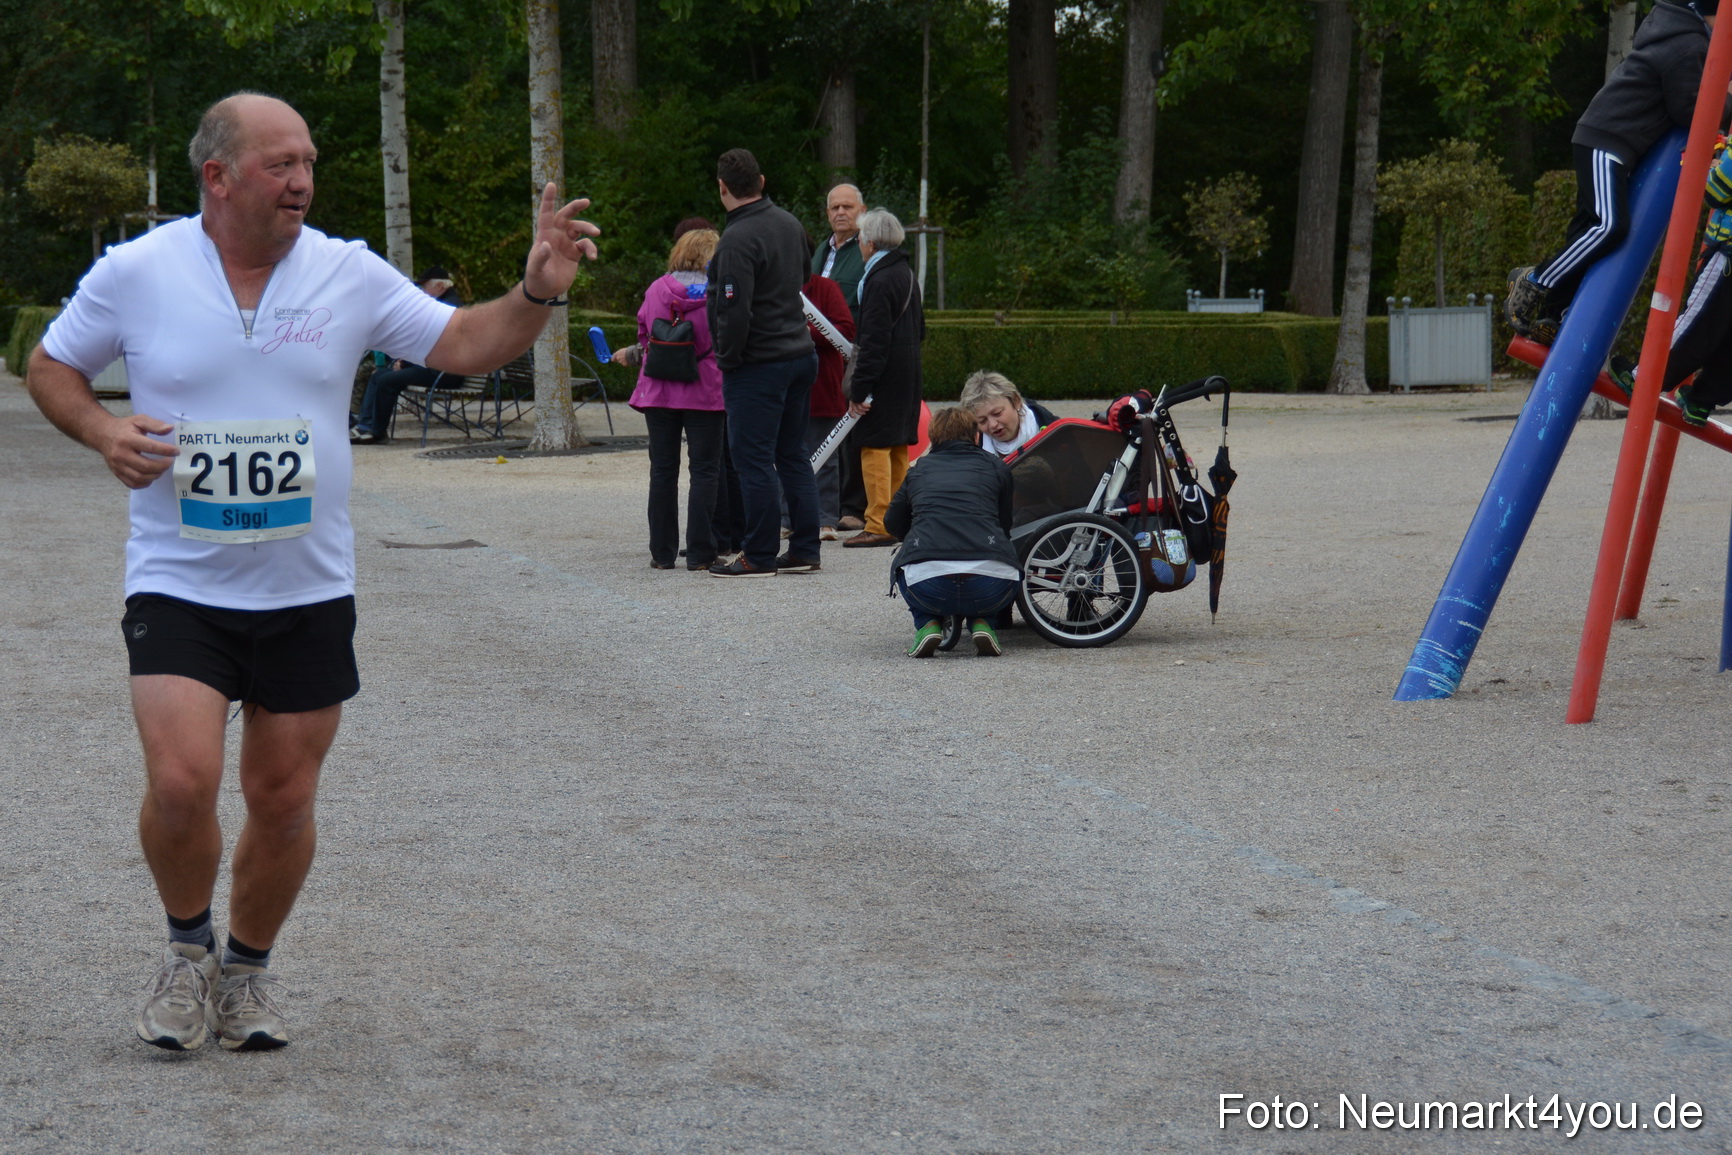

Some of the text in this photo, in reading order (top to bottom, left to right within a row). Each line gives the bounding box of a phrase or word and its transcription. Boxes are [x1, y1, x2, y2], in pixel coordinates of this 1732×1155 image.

[261, 307, 332, 355] Julia
[179, 433, 222, 445] PARTL
[225, 432, 290, 445] Neumarkt
[829, 413, 851, 439] Laufs
[190, 450, 302, 496] 2162
[222, 508, 268, 529] Siggi
